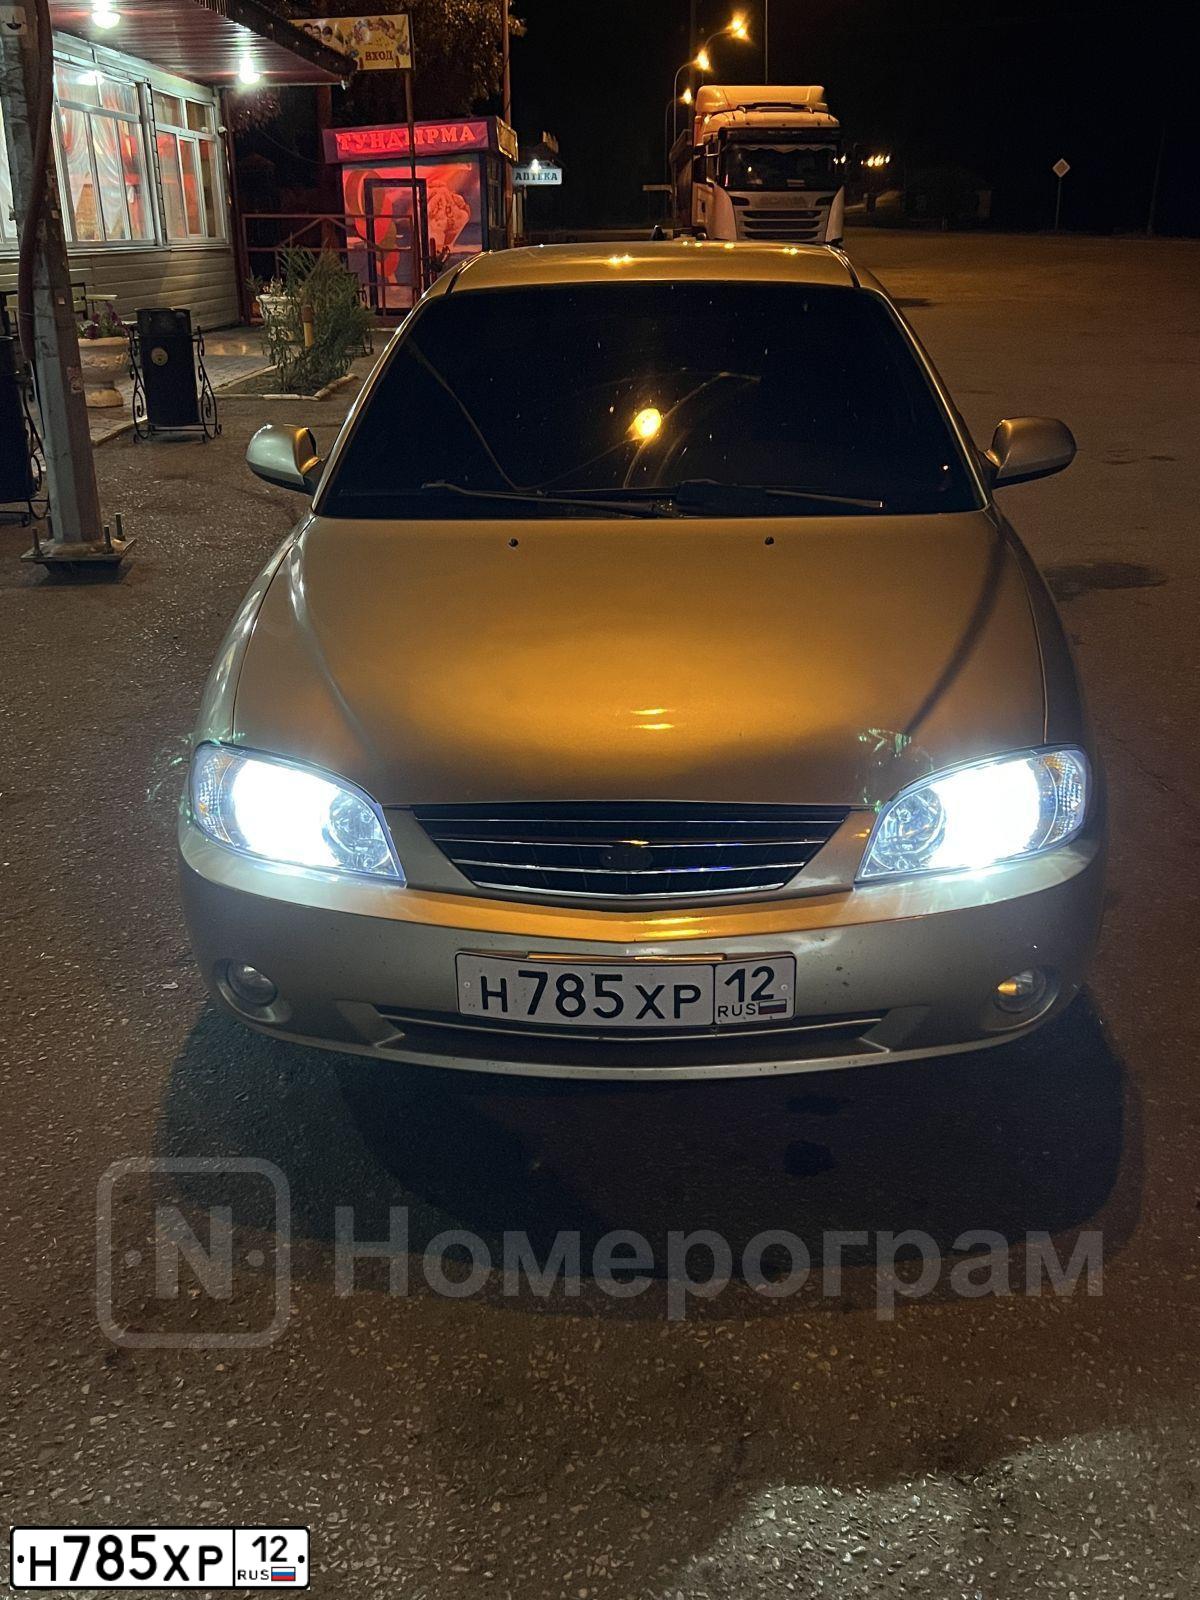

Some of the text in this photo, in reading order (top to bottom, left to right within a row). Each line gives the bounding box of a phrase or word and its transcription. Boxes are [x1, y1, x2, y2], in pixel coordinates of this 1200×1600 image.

[365, 50, 394, 62] ВХОД
[515, 172, 558, 181] АПТЕКА
[724, 966, 776, 1003] 12
[717, 1003, 756, 1018] RUS
